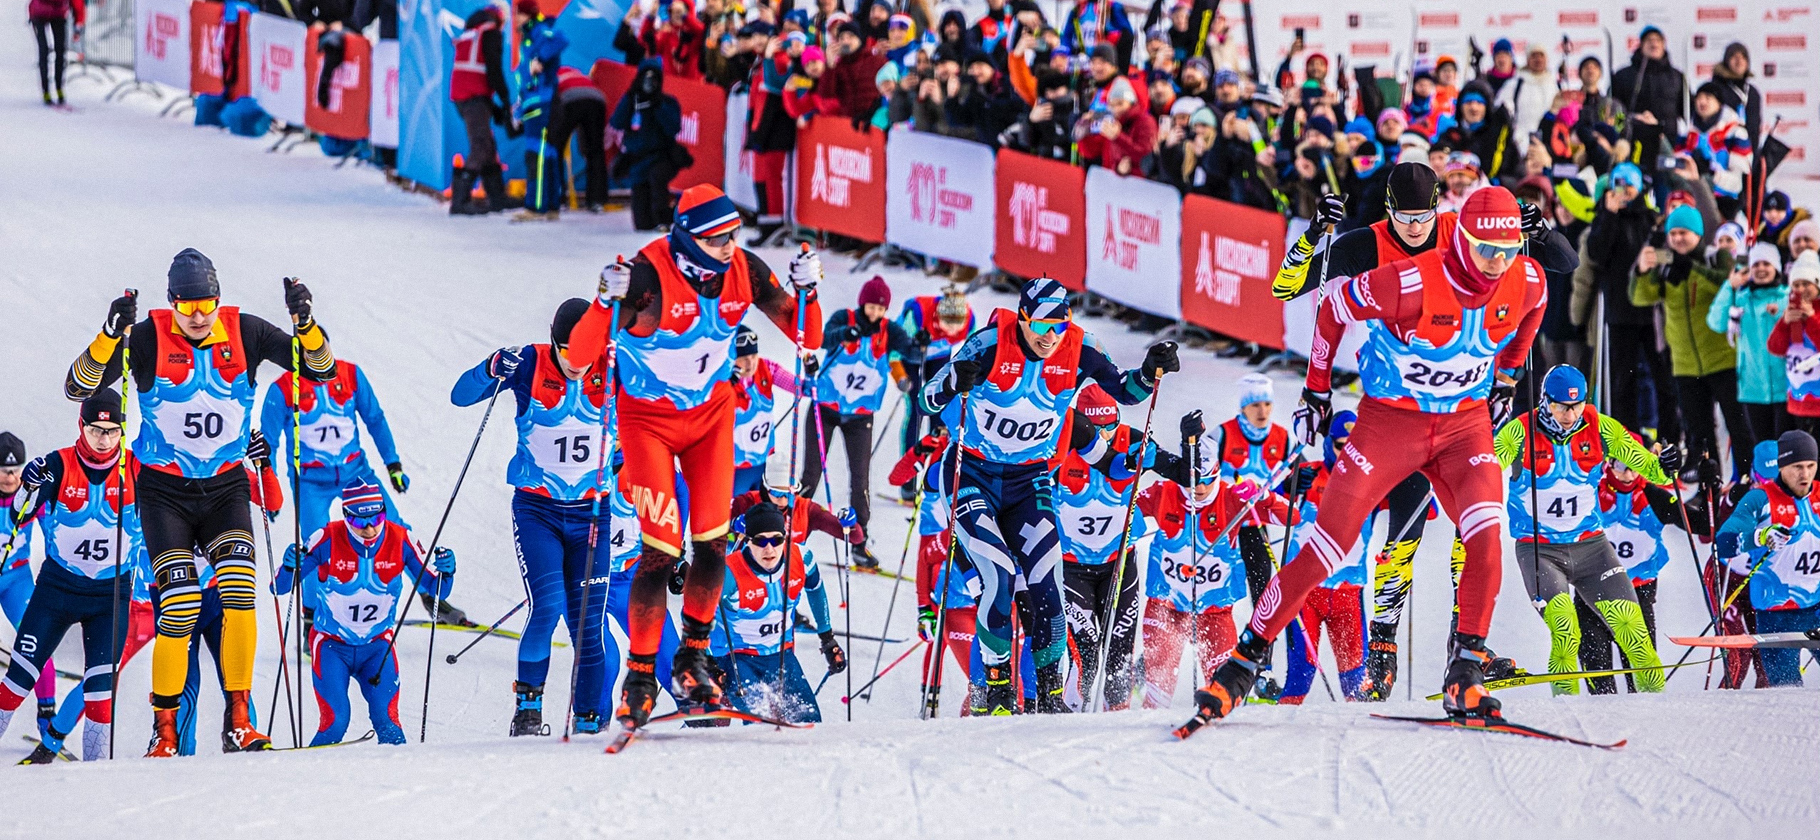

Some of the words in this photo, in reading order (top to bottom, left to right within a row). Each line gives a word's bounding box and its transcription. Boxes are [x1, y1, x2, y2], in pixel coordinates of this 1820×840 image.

[1360, 271, 1376, 307] OSCO
[696, 353, 709, 374] 1
[845, 372, 867, 391] 92
[182, 412, 223, 439] 50
[982, 408, 1054, 441] 1002
[554, 435, 591, 463] 15
[1344, 441, 1374, 475] LUKOIL
[1468, 452, 1499, 467] BOS
[1547, 496, 1578, 517] 41
[1078, 516, 1113, 536] 37
[610, 529, 624, 547] 4
[74, 539, 109, 561] 45
[1164, 557, 1222, 585] 2036
[1795, 551, 1820, 575] 42
[349, 604, 379, 623] 12
[1112, 597, 1139, 638] RUSS
[949, 631, 975, 642] BOSC
